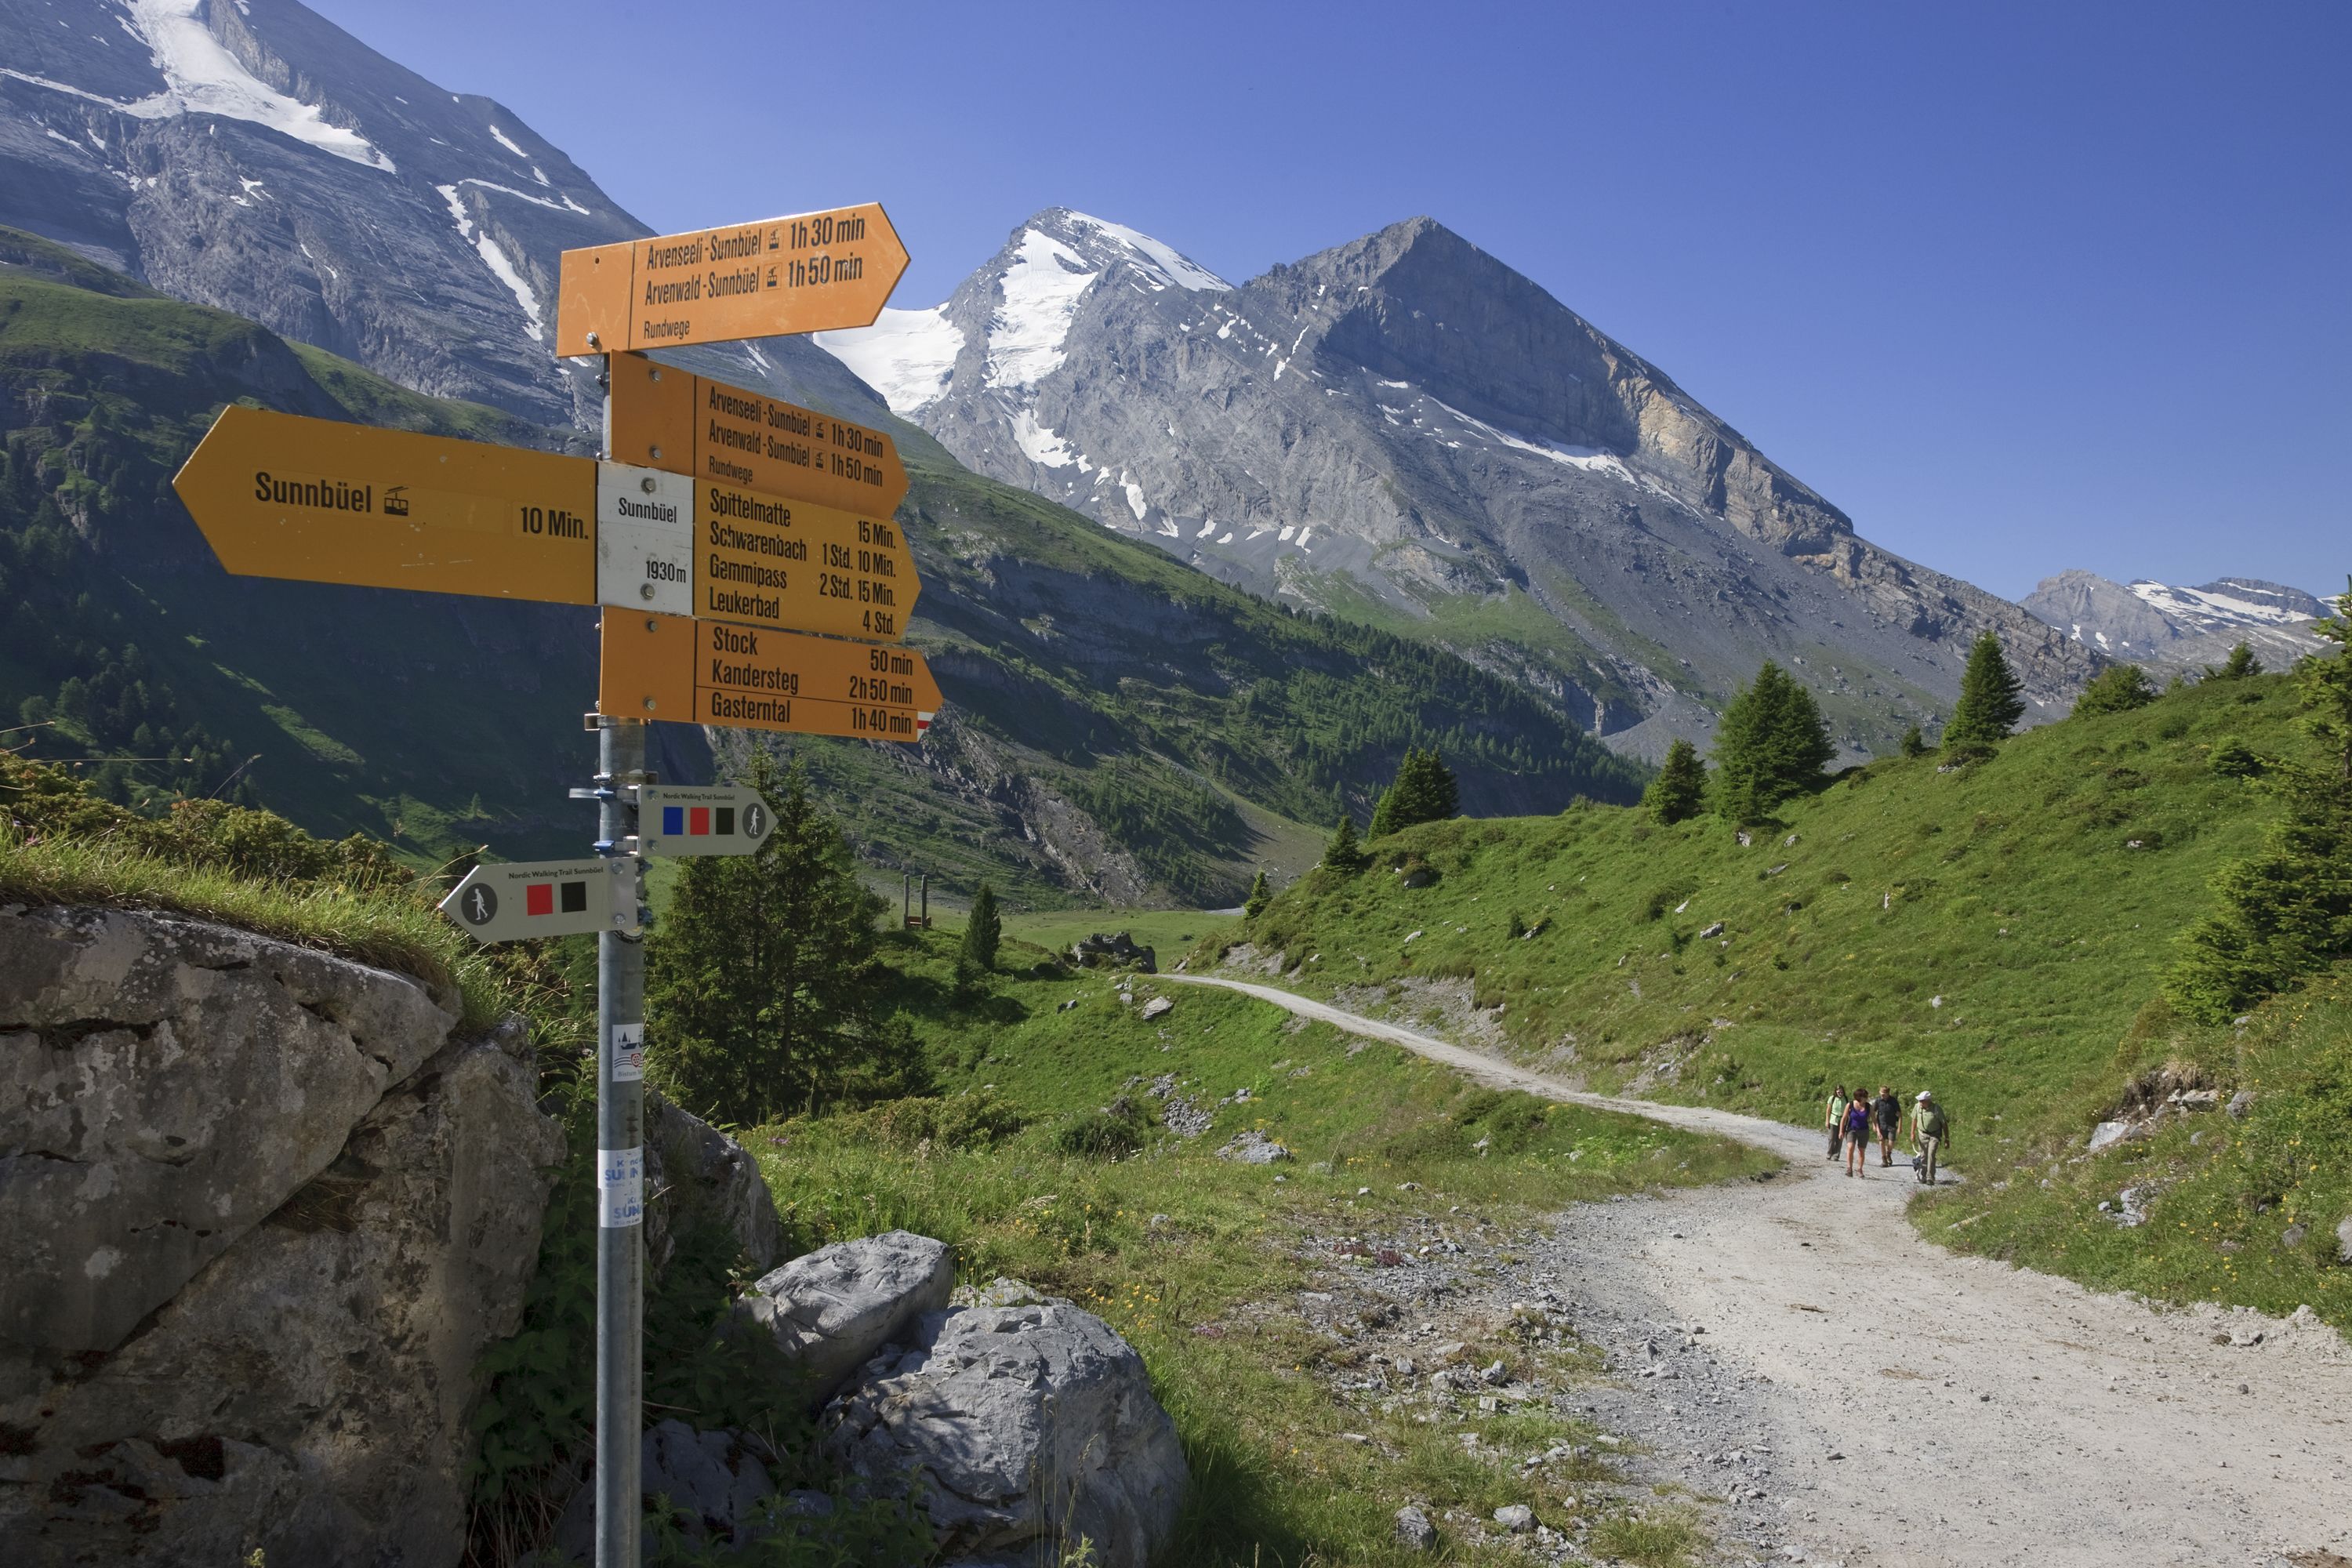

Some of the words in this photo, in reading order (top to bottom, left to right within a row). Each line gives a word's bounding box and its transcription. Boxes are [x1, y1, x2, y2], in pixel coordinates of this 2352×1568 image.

[790, 222, 807, 249] 1h
[811, 217, 833, 247] 30
[837, 213, 865, 243] min
[789, 260, 804, 287] 1h
[808, 256, 829, 285] 50
[833, 252, 862, 281] min
[644, 320, 689, 339] Rundwege
[832, 423, 844, 447] 1h
[848, 427, 861, 452] 30
[865, 436, 883, 458] min
[710, 456, 753, 485] Rundwege
[832, 453, 844, 477] 1h
[847, 457, 861, 481] 50
[864, 465, 882, 487] min
[255, 471, 372, 513] Sunnbüel
[710, 488, 790, 527] Spittelmatte
[521, 506, 543, 533] 10
[548, 509, 589, 539] Min.
[619, 498, 677, 524] Sunnbüel
[710, 521, 807, 561] Schwarenbach
[822, 543, 828, 564] 1
[830, 546, 853, 570] Std.
[858, 550, 869, 572] 10
[873, 554, 896, 577] Min.
[858, 521, 869, 543] 15
[873, 524, 896, 549] Min.
[710, 554, 787, 589] Gemmipass
[820, 573, 827, 596] 2
[830, 576, 853, 600] Std.
[858, 579, 869, 601] 15
[873, 583, 896, 607] Min.
[710, 587, 779, 619] Leukerbad
[862, 611, 870, 632] 4
[874, 613, 896, 635] Std.
[713, 626, 757, 656] Stock
[870, 649, 888, 672] 50
[891, 652, 913, 676] min
[713, 659, 798, 695] Kandersteg
[849, 677, 866, 699] 2h
[869, 679, 887, 702] 50
[891, 681, 913, 705] min
[711, 692, 790, 723] Gasterntal
[851, 707, 866, 730] 1h
[869, 709, 887, 732] 40
[891, 712, 912, 735] min
